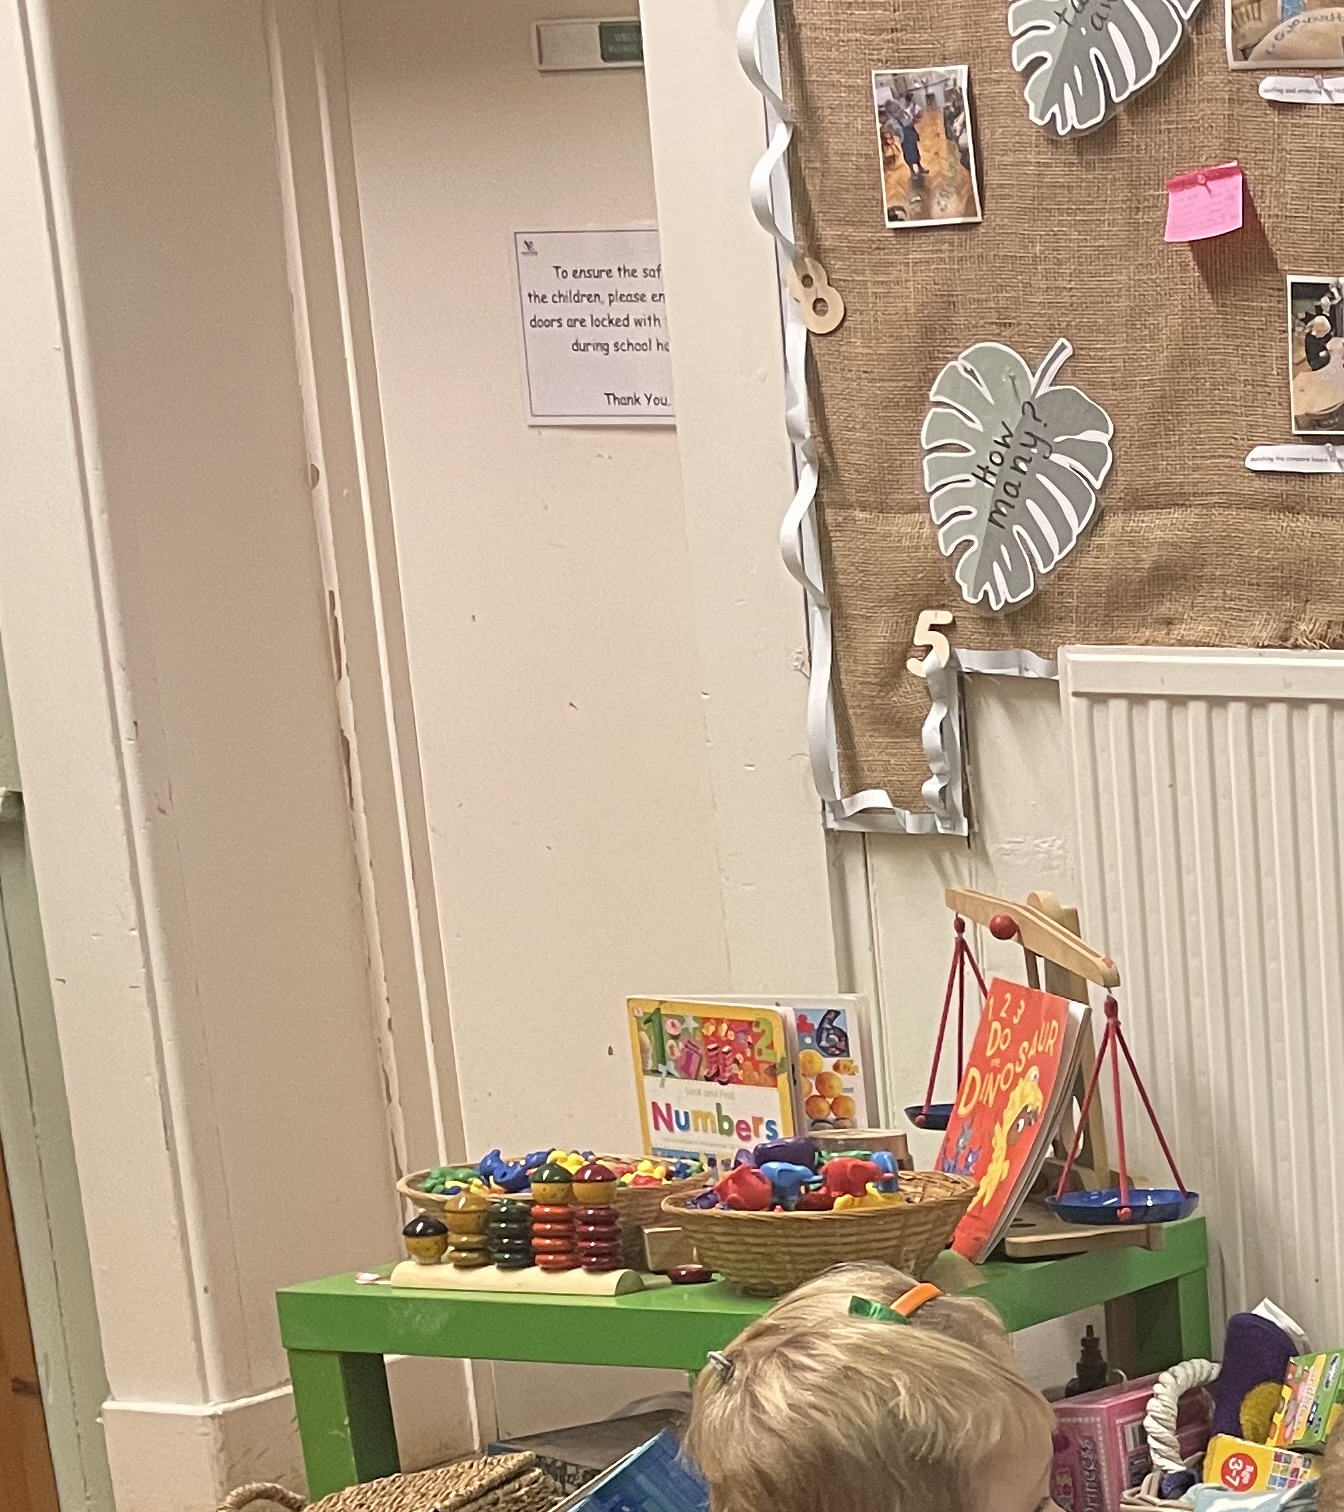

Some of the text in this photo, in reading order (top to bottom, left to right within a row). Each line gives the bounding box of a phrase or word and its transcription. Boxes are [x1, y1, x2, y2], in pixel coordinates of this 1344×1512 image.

[552, 265, 568, 279] To
[572, 267, 613, 279] ensure
[618, 264, 638, 279] the
[528, 291, 548, 304] the
[608, 290, 647, 307] please
[530, 314, 661, 328] doors are locked with
[572, 339, 610, 356] during
[614, 338, 652, 352] school
[604, 392, 642, 406] Thank
[972, 420, 1014, 488] How
[988, 400, 1053, 530] many?
[906, 610, 953, 677] 5
[988, 992, 1026, 1024] 1 2 3
[816, 1009, 850, 1057] 6
[652, 1100, 779, 1142] Numbers
[1225, 1456, 1244, 1488] 3-7
